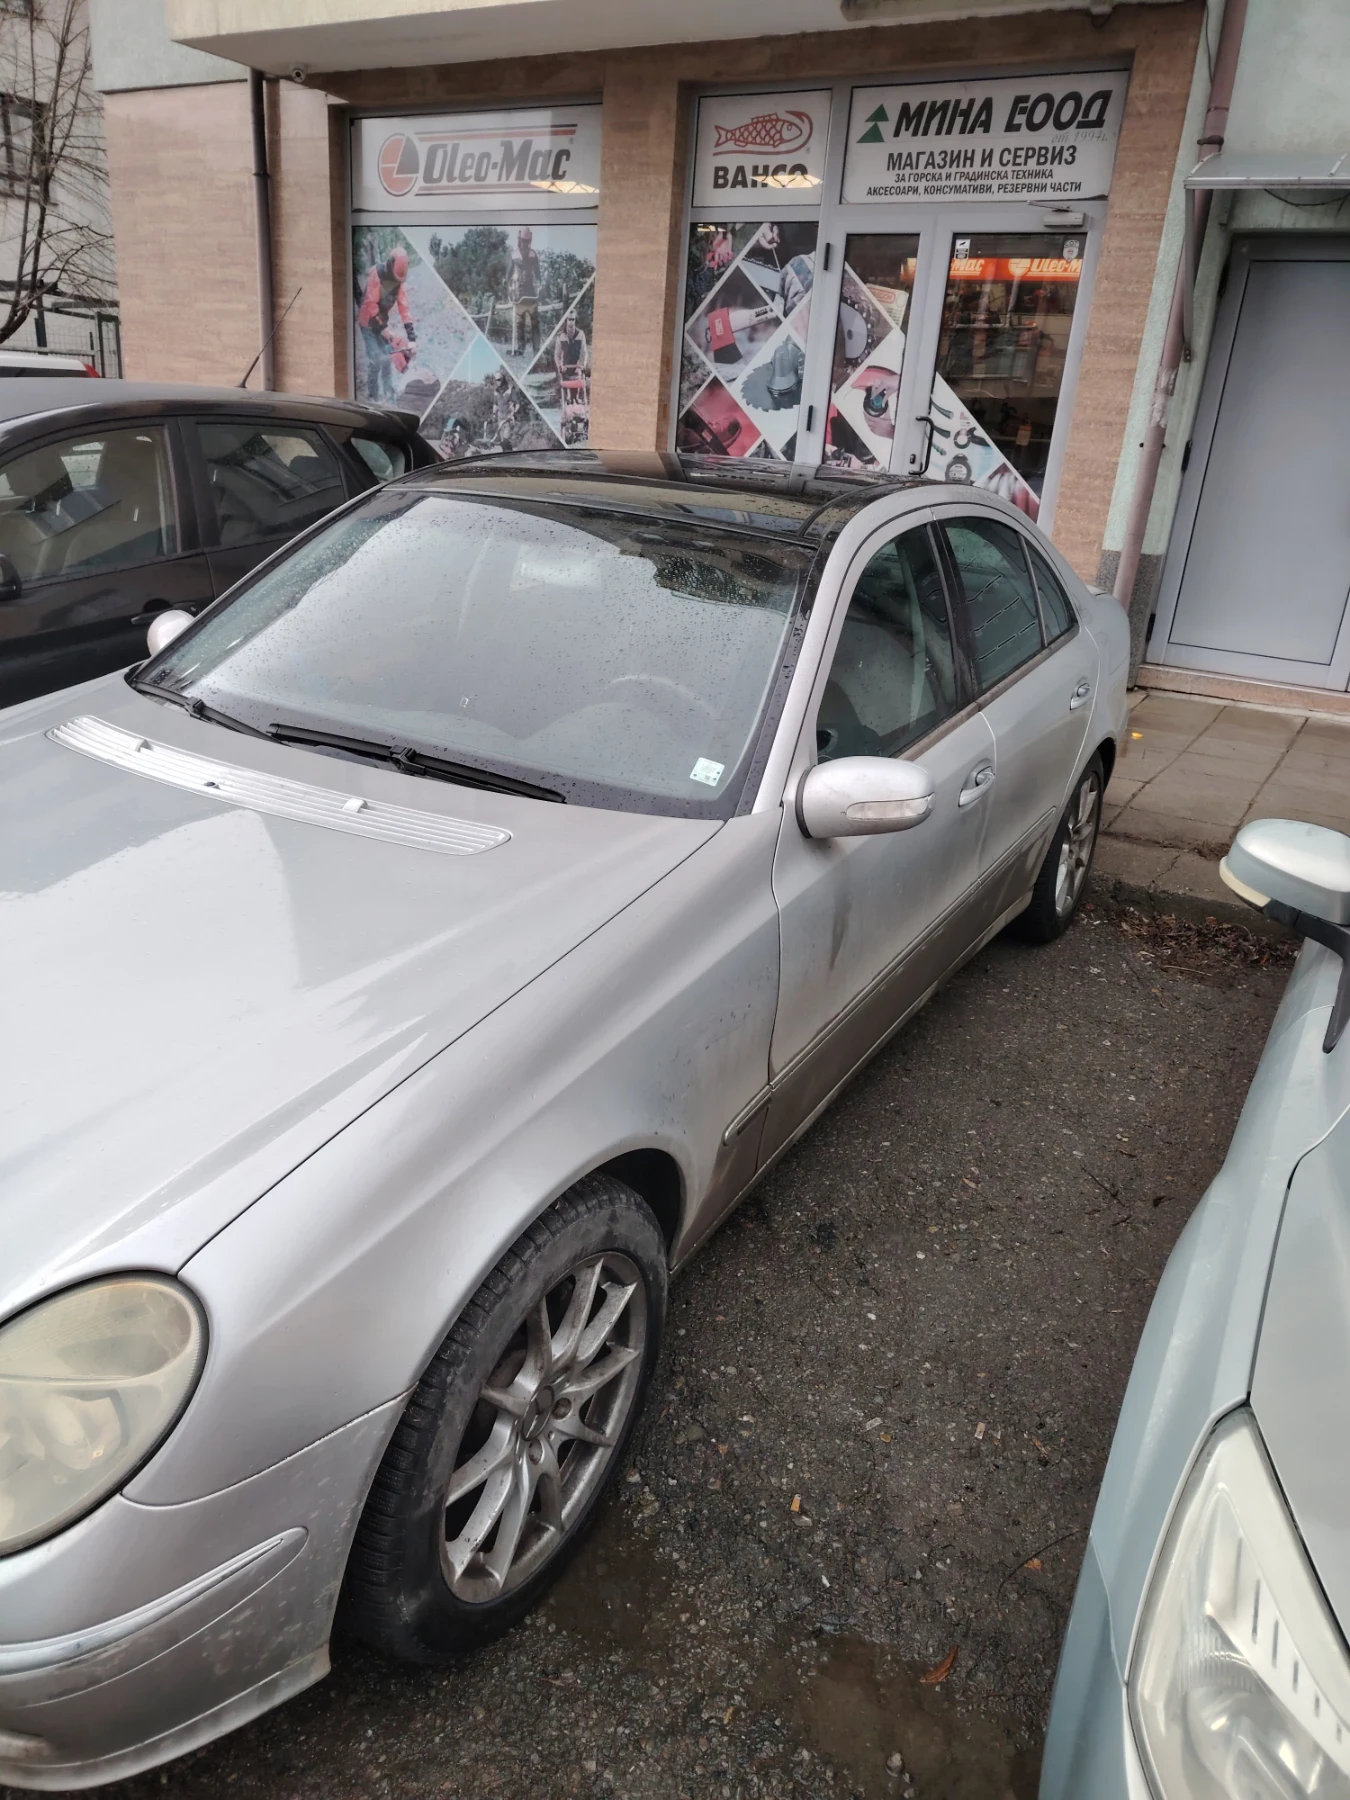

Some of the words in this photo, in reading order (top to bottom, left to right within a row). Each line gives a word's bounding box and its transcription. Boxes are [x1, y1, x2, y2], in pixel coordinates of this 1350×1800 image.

[893, 96, 993, 138] МИНА
[1004, 89, 1113, 132] ЕООД
[422, 139, 571, 184] Oleo-Mac
[887, 149, 975, 171] МАГАЗИН
[980, 148, 994, 168] И
[999, 145, 1077, 167] СЕРВИЗ
[866, 186, 921, 196] АКСЕСОАРИ,
[923, 184, 995, 195] КОНСУМАТИВИ,
[997, 182, 1048, 193] РЕЗЕРВНИ
[1050, 181, 1082, 192] ЧАСТИ
[894, 173, 906, 183] ЗА
[908, 172, 943, 182] ГОРСКА
[945, 172, 951, 181] И
[954, 170, 1008, 182] ГРАДИНСКА
[1011, 169, 1053, 180] ТЕХНИКА
